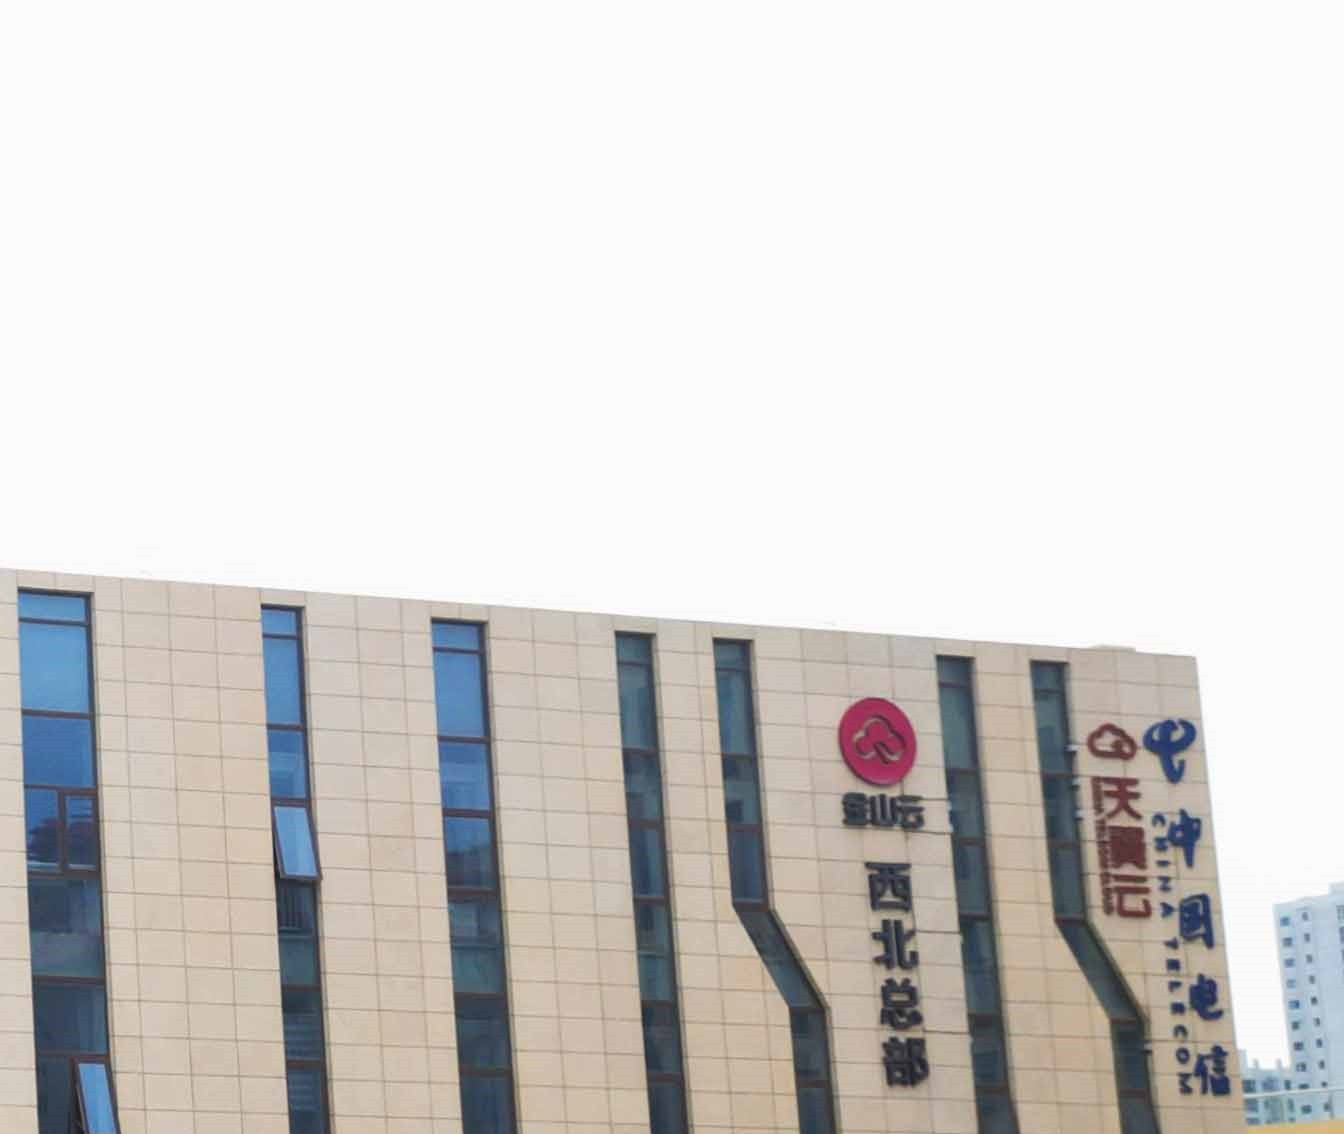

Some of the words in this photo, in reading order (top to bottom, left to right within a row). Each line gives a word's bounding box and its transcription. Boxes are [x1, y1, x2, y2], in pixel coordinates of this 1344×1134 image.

[842, 792, 925, 830] 金山云
[864, 861, 930, 1088] 西北总部
[1152, 811, 1176, 918] CHINA
[1164, 936, 1192, 1096] TELECOM
[1167, 808, 1231, 1097] 中国电信
